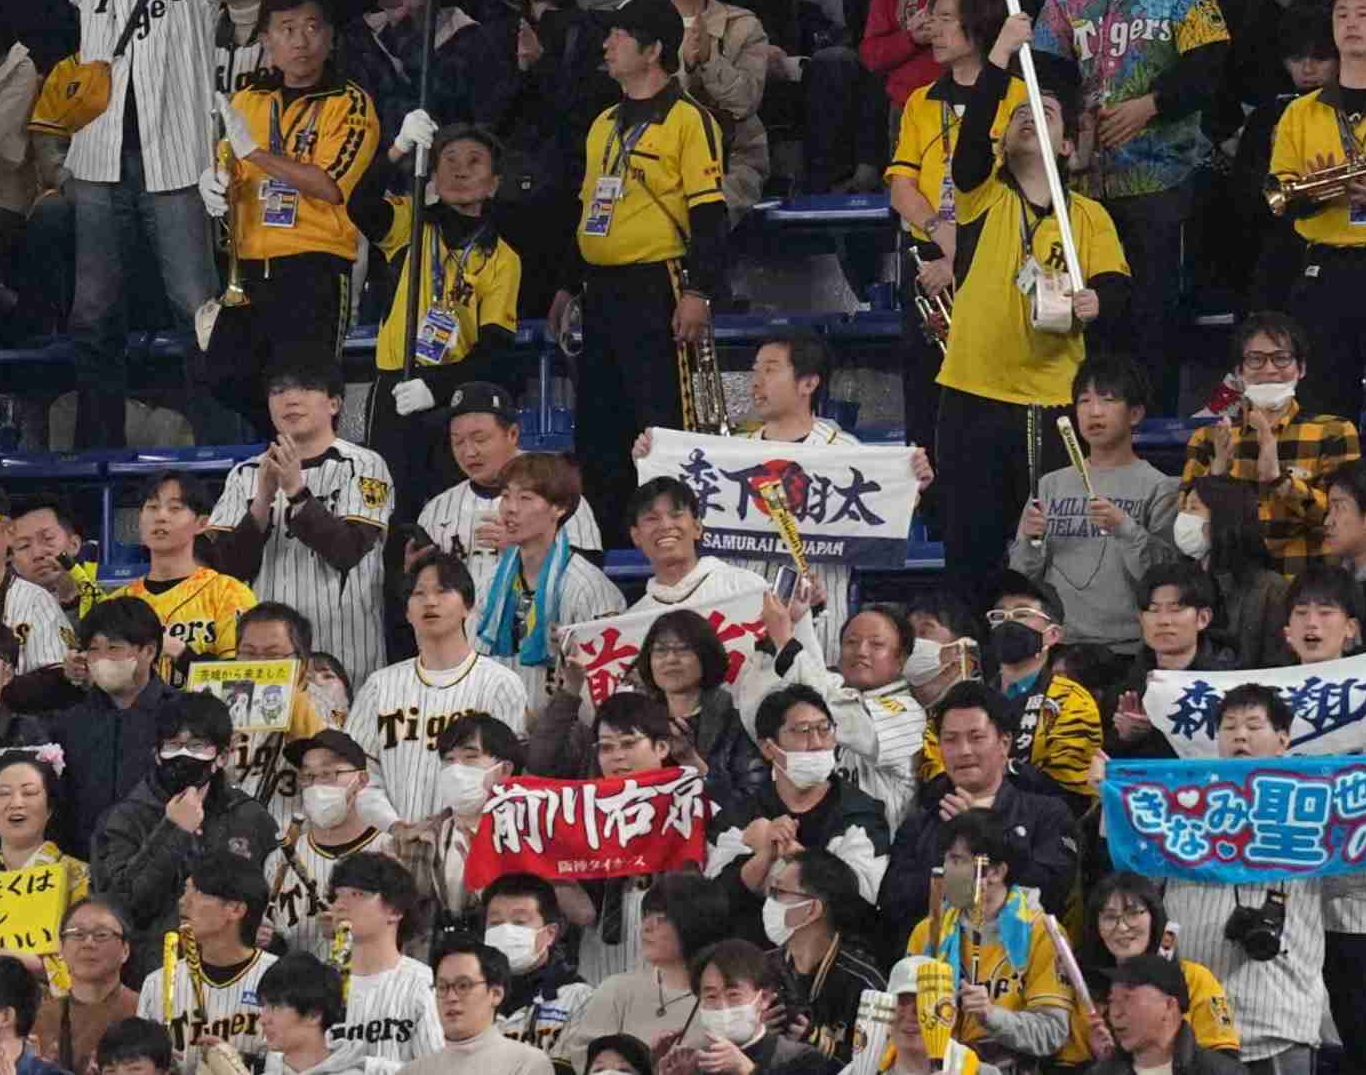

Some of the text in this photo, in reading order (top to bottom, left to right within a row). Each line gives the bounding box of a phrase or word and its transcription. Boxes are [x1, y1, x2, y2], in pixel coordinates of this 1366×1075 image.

[1072, 15, 1173, 62] Tigers
[701, 530, 845, 557] SAMURAI JAPAN
[486, 777, 720, 855] 前川右京
